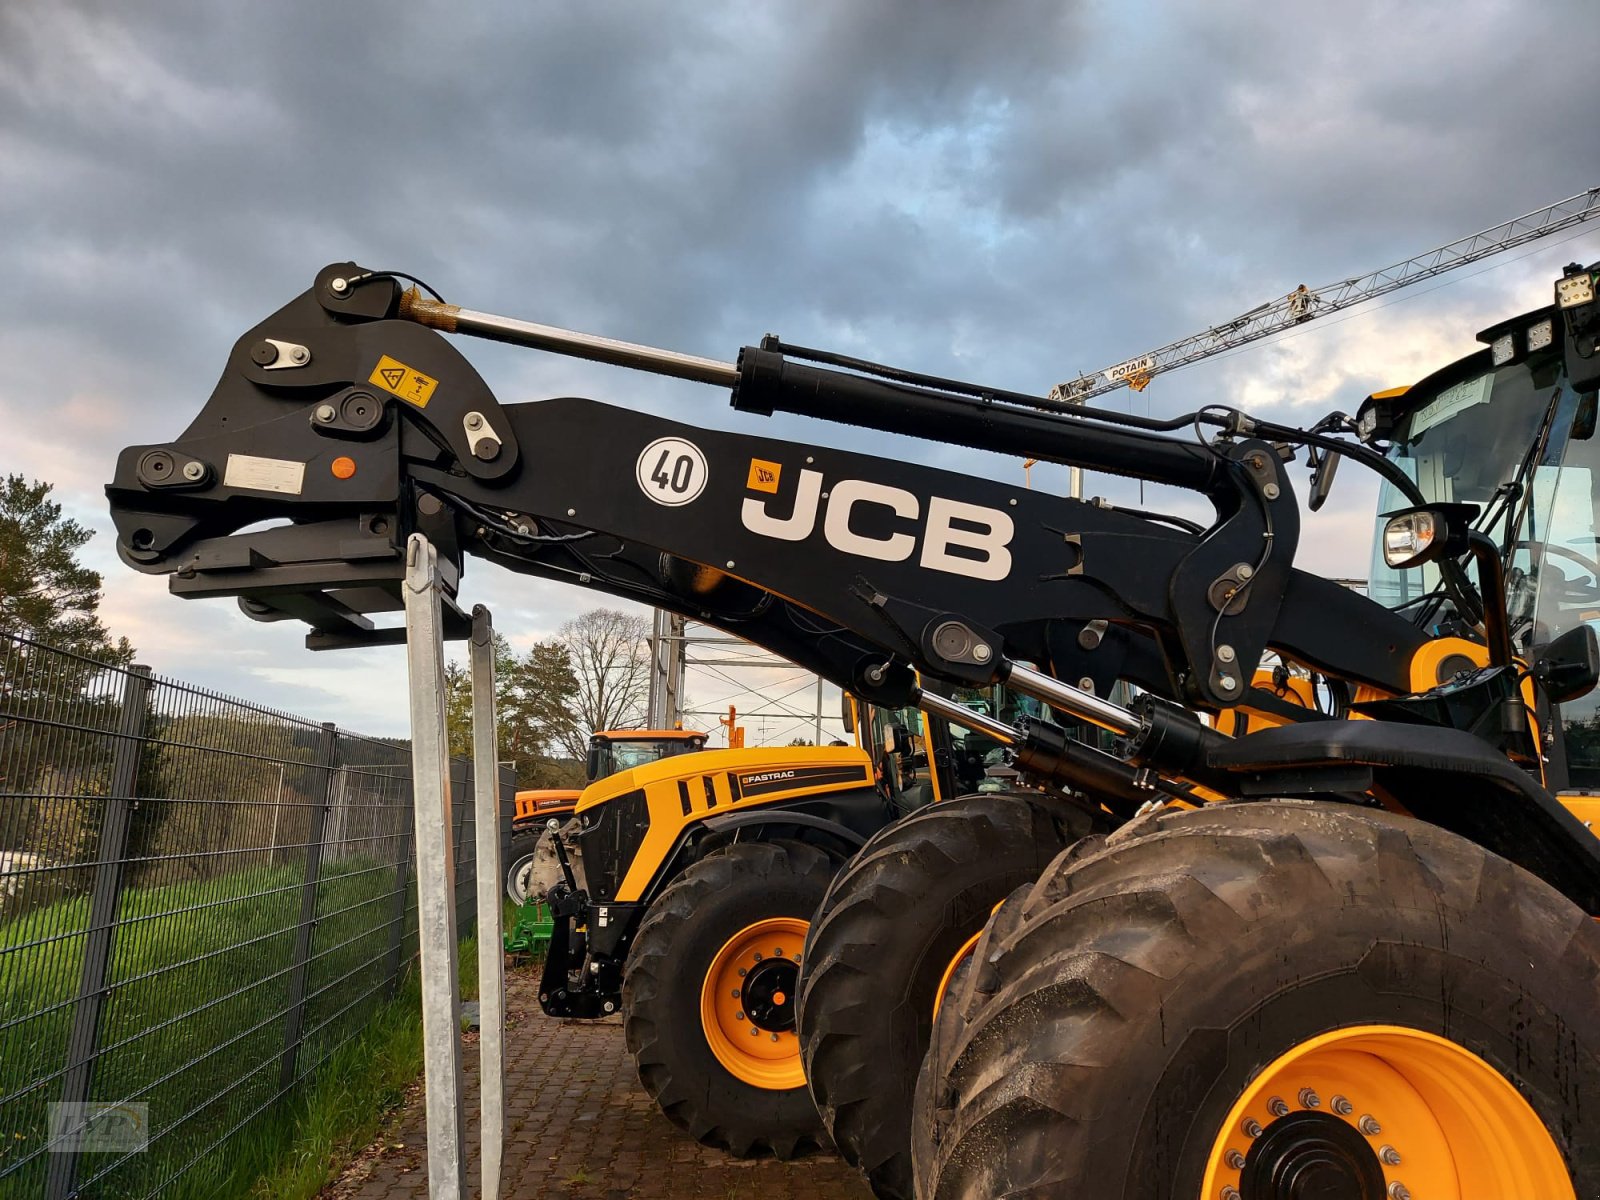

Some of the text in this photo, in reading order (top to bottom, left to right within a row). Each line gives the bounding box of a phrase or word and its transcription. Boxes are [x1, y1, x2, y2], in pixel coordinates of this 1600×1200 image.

[1112, 359, 1148, 378] POTAIN
[650, 449, 694, 494] 40
[757, 468, 774, 482] JCB
[740, 468, 1016, 582] JCB
[748, 770, 795, 783] FASTRAC
